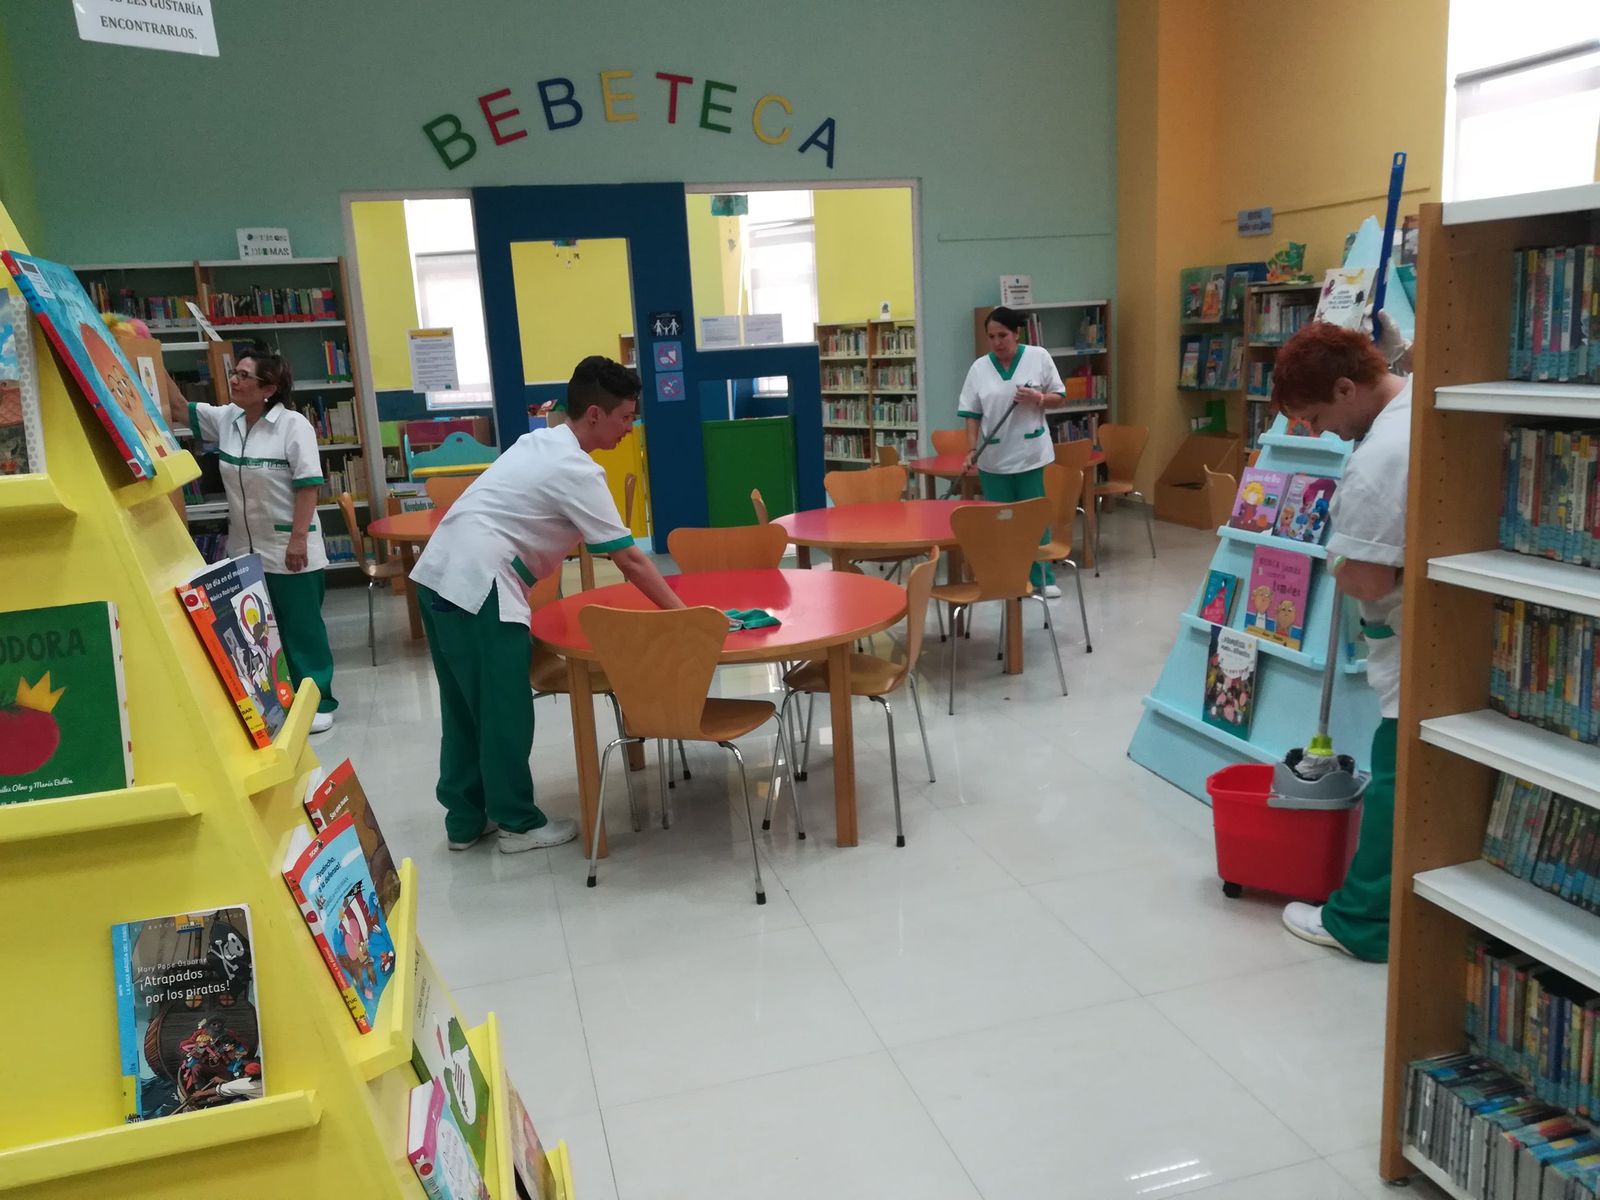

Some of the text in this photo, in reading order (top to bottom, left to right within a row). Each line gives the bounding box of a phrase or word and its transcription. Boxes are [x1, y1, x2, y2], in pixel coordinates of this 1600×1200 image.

[100, 15, 198, 40] ENCONTRARLOS.
[422, 70, 836, 170] BEBETECA
[204, 582, 212, 591] Un
[221, 575, 227, 583] en
[227, 571, 232, 580] el
[233, 566, 249, 577] museo
[137, 965, 155, 974] Mary
[157, 962, 175, 971] Pope
[140, 969, 203, 991] ¡Atrapados
[145, 980, 230, 1006] por los piratas!
